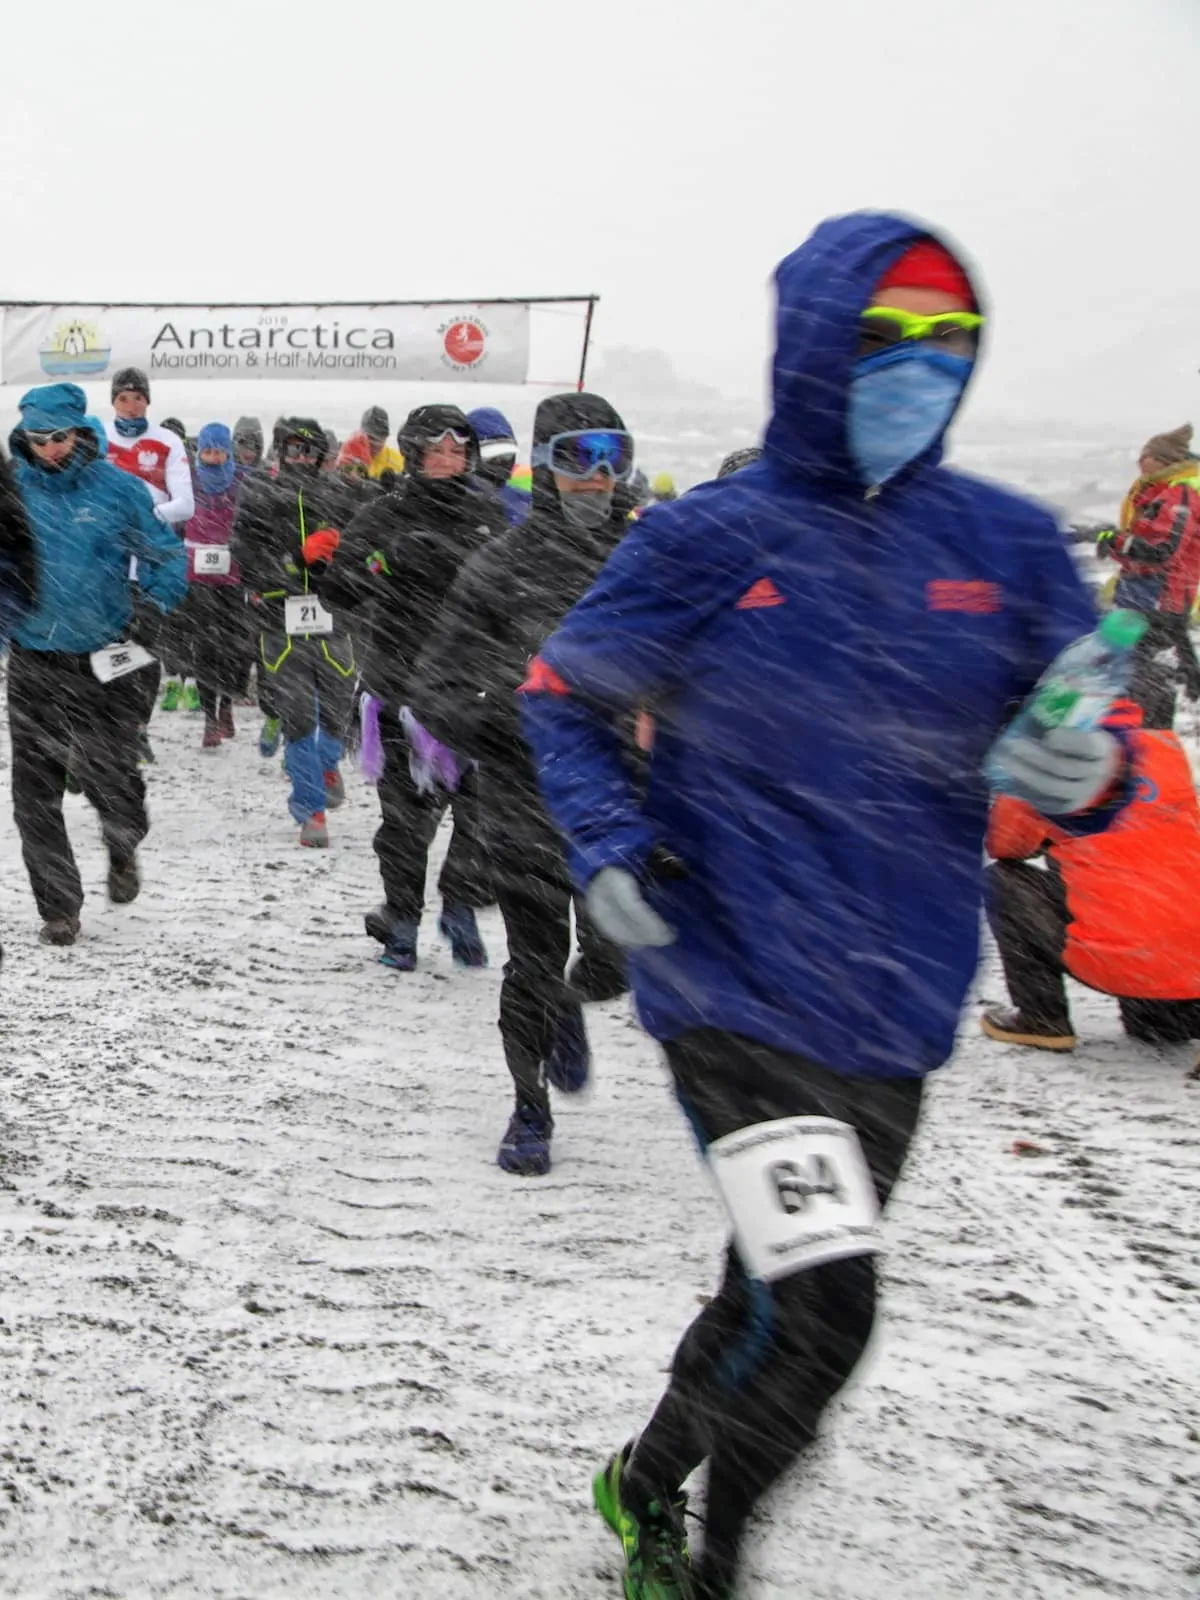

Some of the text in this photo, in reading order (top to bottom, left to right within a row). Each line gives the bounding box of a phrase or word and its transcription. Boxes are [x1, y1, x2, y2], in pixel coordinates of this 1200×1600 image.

[150, 321, 395, 350] Antarctica
[151, 351, 398, 369] Marathon & Half-Marathon
[205, 552, 220, 565] 39
[300, 606, 317, 621] 21
[765, 1152, 847, 1214] 64
